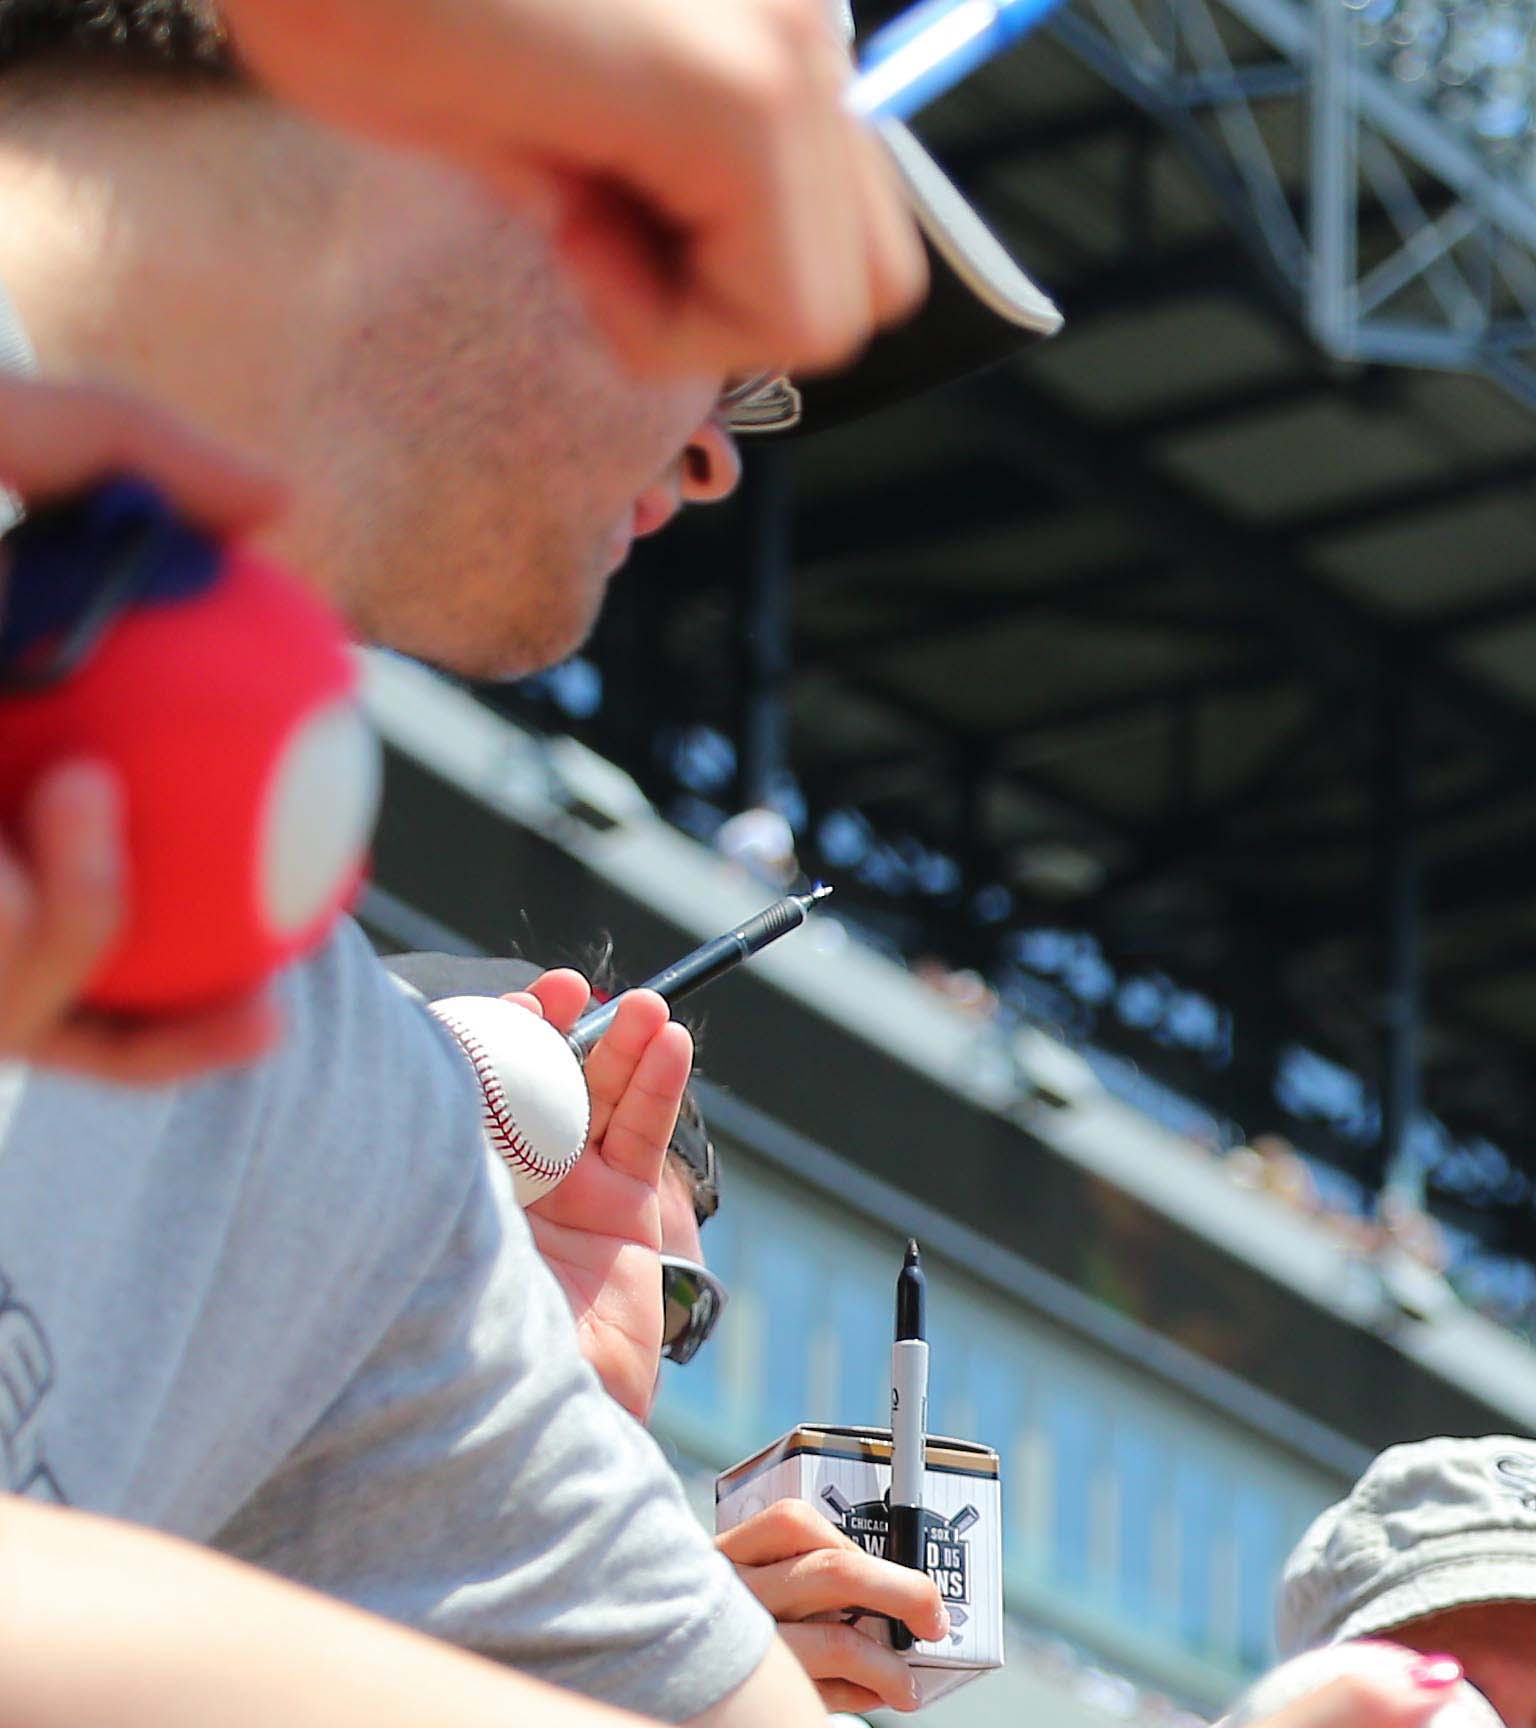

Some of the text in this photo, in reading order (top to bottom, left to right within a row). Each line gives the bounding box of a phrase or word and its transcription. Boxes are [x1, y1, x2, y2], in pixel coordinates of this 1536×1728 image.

[850, 1516, 950, 1541] CHICAG SOX
[944, 1548, 961, 1569] 05
